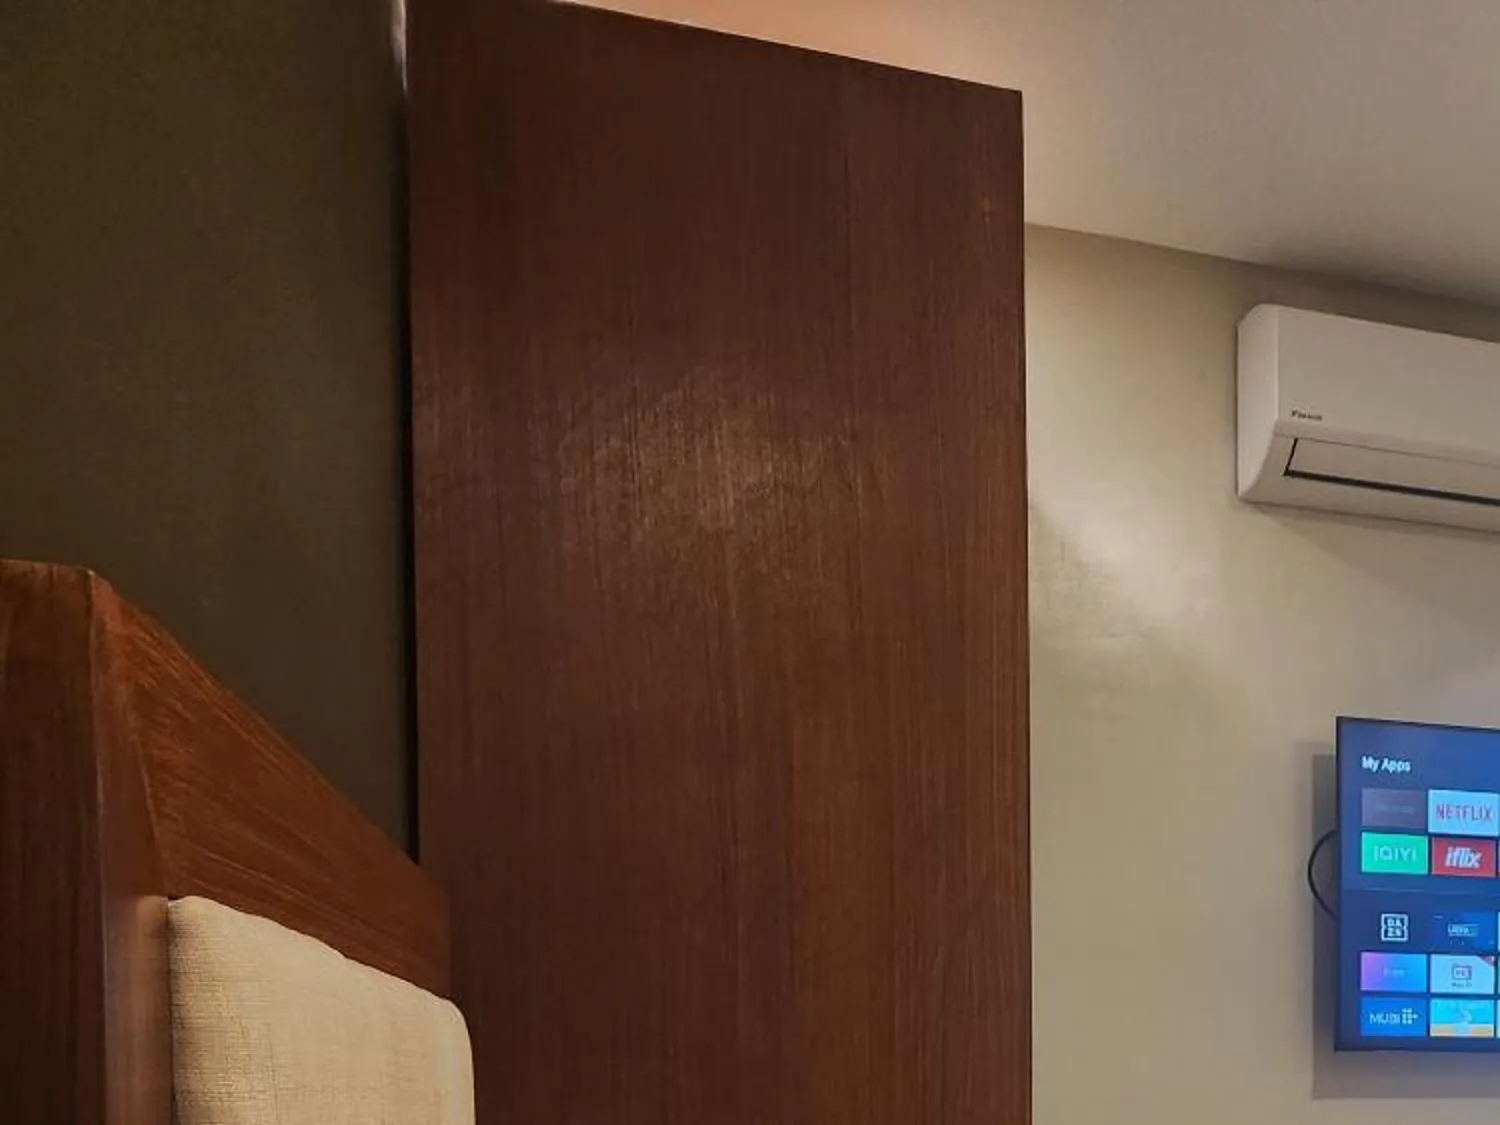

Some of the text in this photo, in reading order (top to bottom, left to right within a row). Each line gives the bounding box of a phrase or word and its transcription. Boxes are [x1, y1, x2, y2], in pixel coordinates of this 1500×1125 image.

[1362, 756, 1410, 773] My Apps
[1436, 803, 1492, 821] NETFLIX
